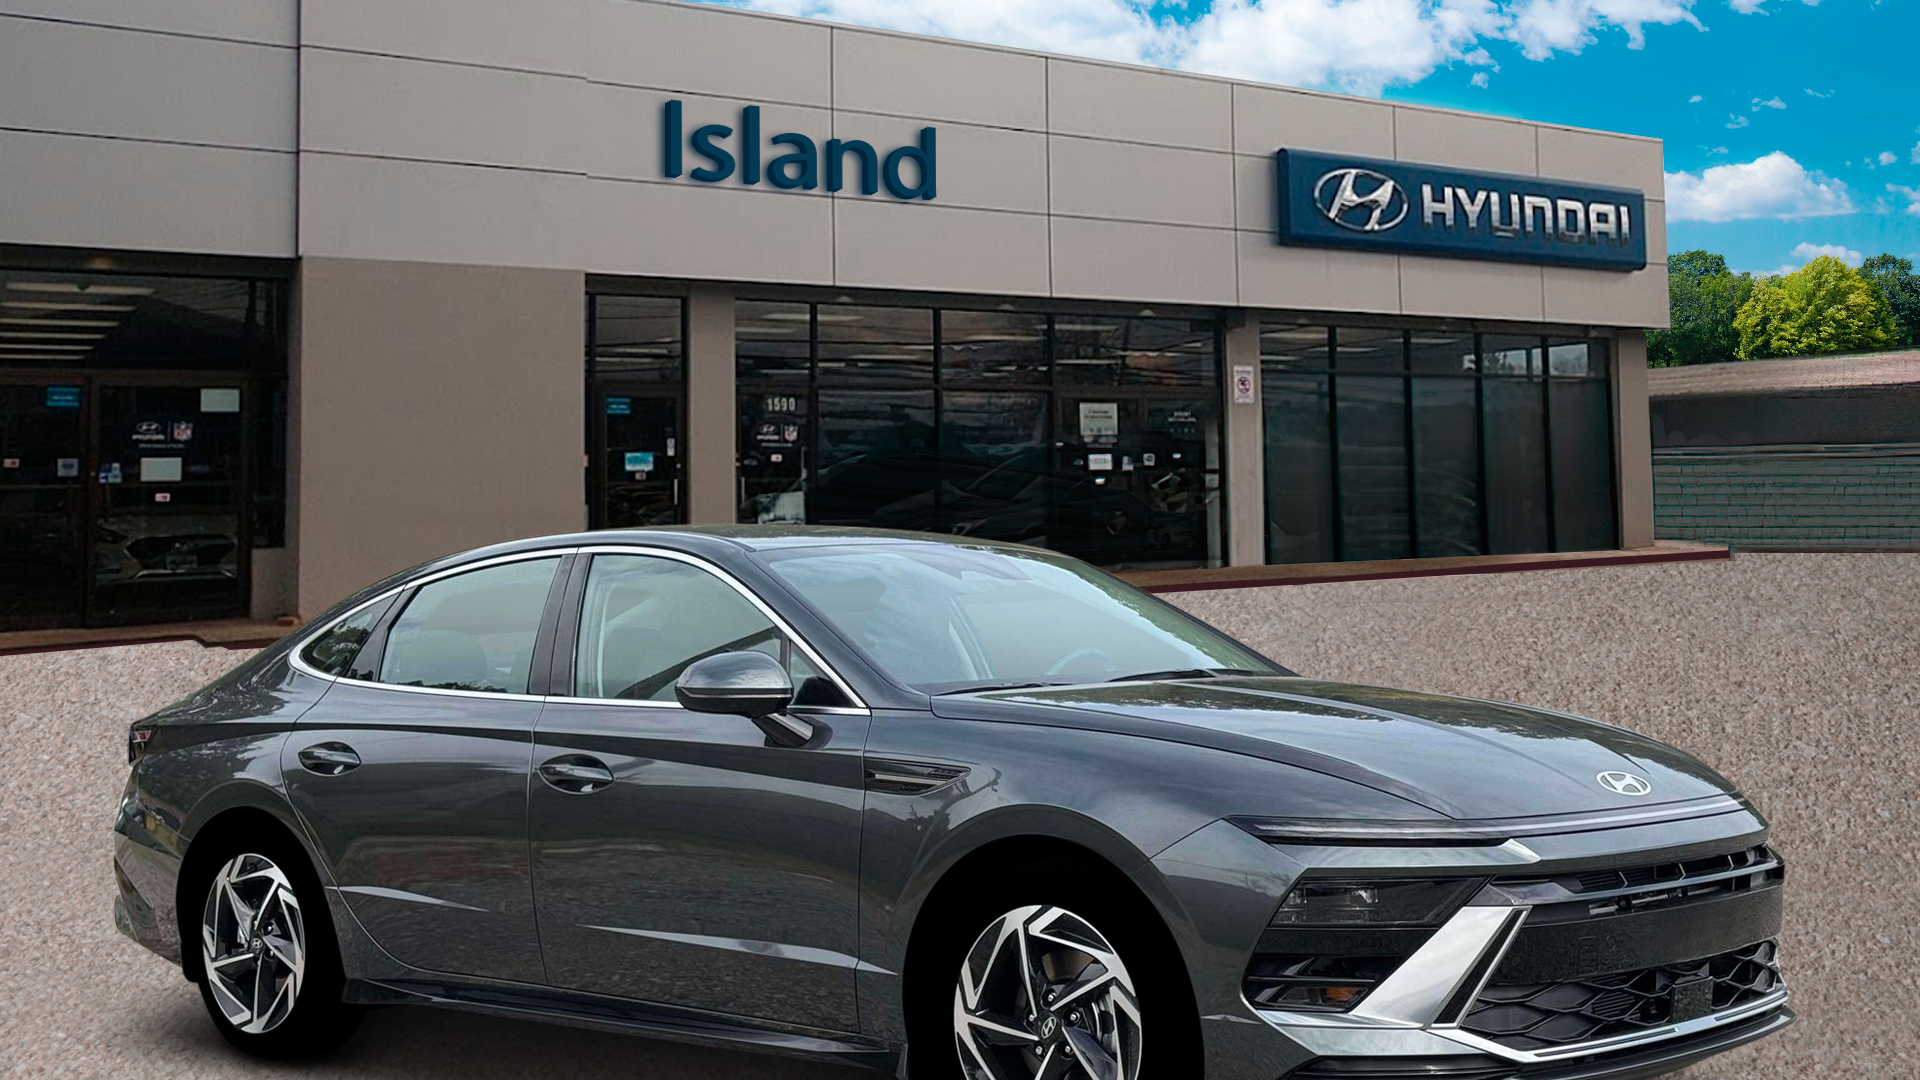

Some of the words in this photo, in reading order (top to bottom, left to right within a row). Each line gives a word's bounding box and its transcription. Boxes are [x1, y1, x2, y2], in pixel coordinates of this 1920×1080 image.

[664, 99, 937, 201] Island
[1421, 183, 1630, 243] HYUNDAI
[767, 397, 796, 411] 1590
